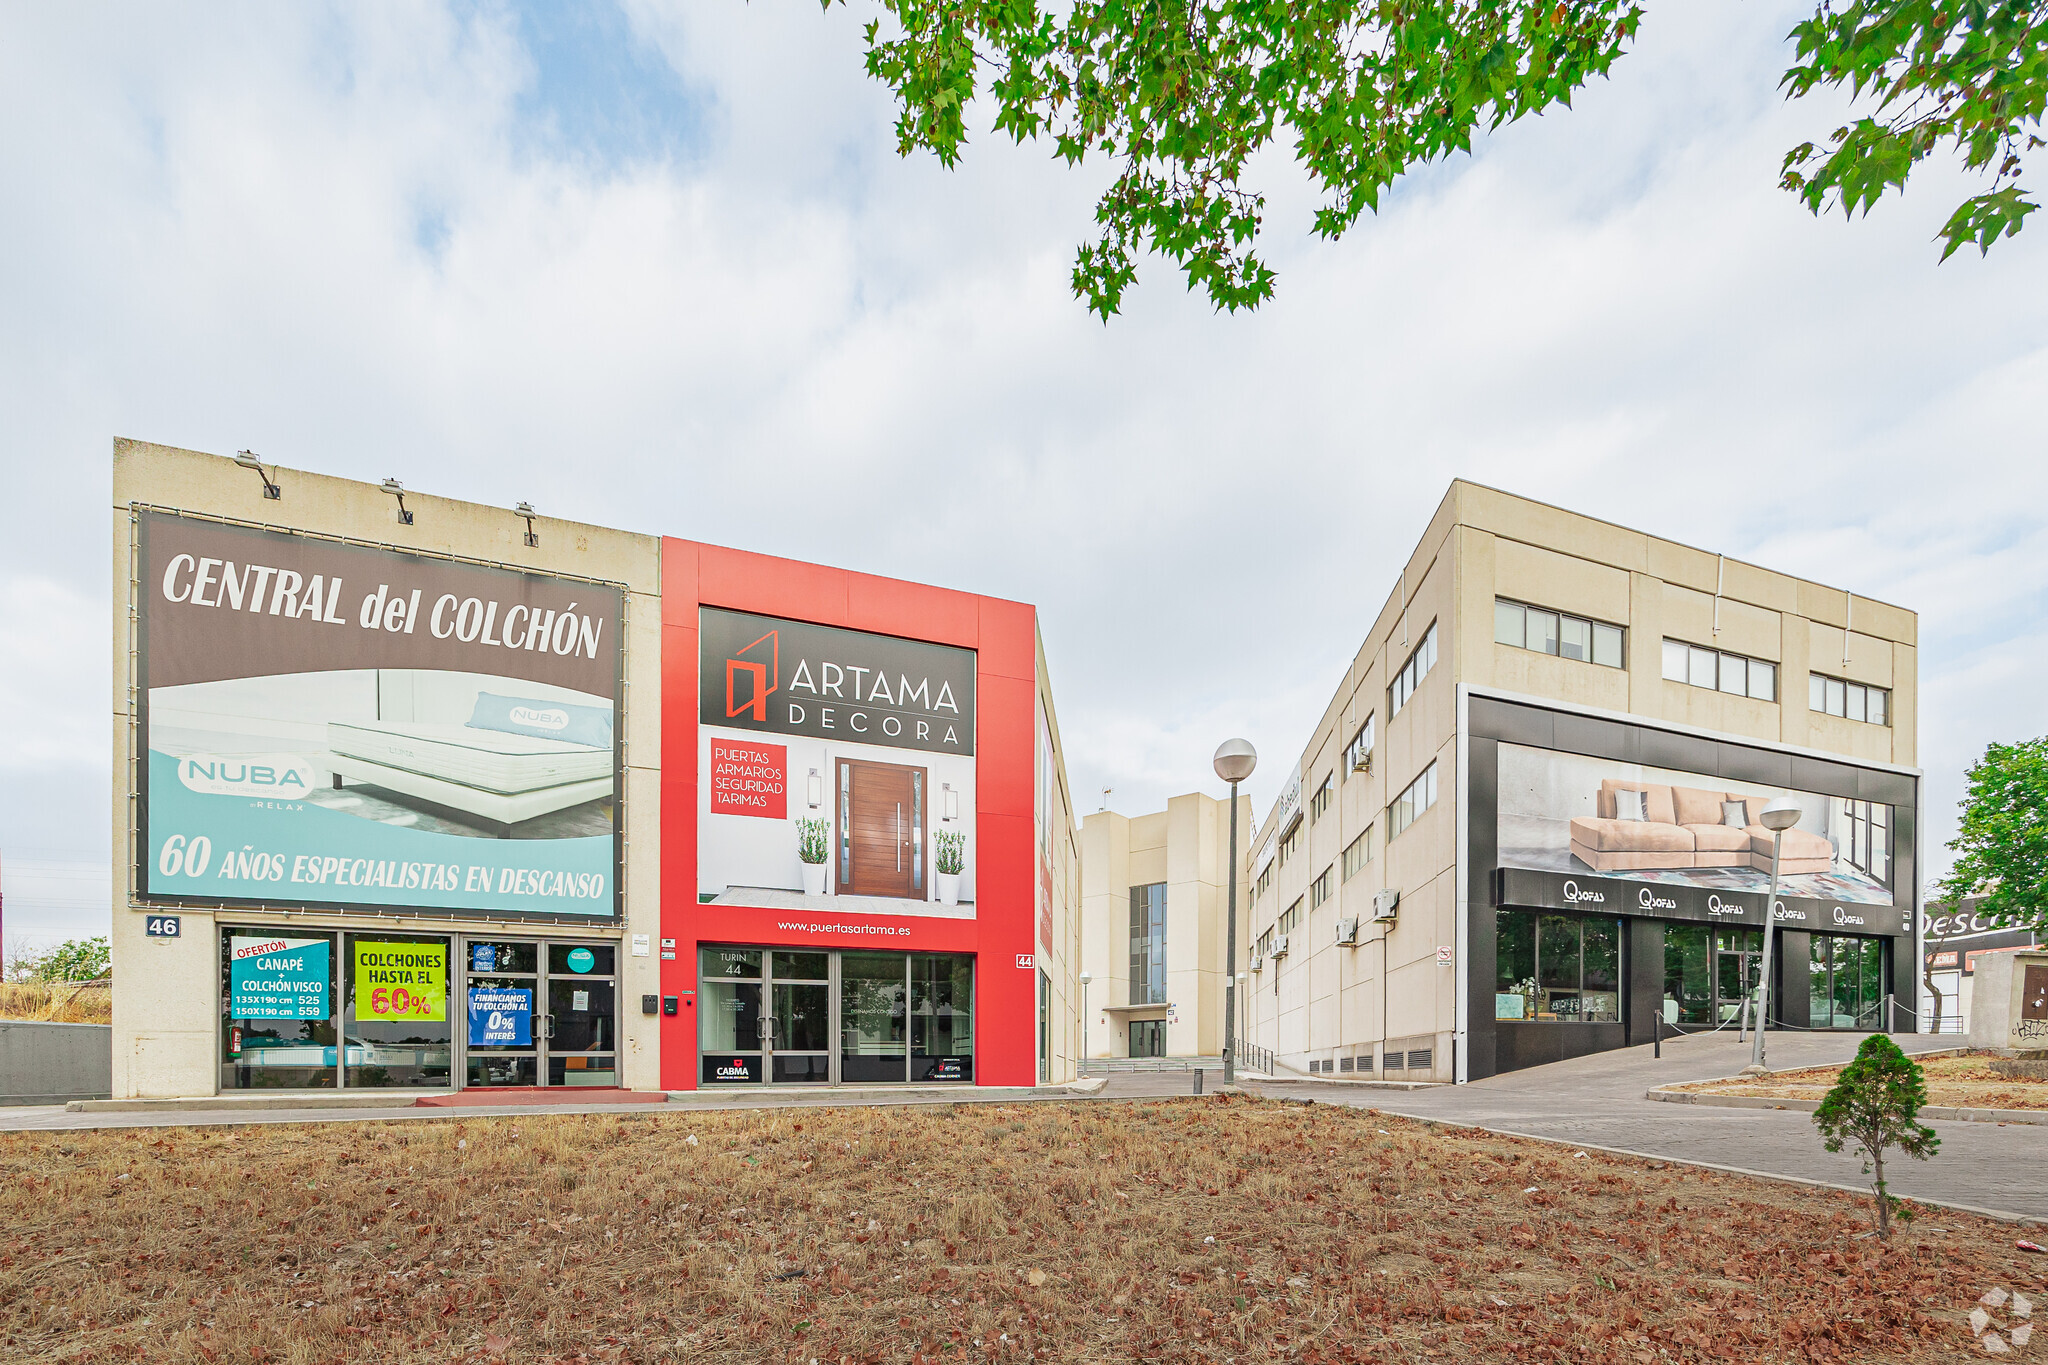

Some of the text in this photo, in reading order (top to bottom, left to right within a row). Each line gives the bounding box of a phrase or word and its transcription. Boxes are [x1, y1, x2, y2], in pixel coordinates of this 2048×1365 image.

[162, 553, 604, 659] CENTRAL del COLCHÓN
[788, 658, 960, 714] ARTAMA
[513, 708, 564, 725] NUBA
[788, 703, 959, 745] DECORA
[715, 747, 770, 764] PUERTAS
[188, 760, 305, 788] NUBA
[715, 763, 782, 780] ARMARIOS
[715, 777, 783, 794] SEGURIDAD
[257, 801, 304, 812] RELAX
[715, 791, 767, 807] TARIMAS
[158, 834, 605, 899] 60 AÑOS ESPECIALISTAS EN DESCANSO
[149, 918, 177, 935] 46
[777, 921, 911, 936] www.puertasartama.es
[236, 940, 287, 959] OFERTÓN
[256, 957, 304, 971] CANAPÉ
[360, 953, 441, 968] COLCHONES
[720, 953, 747, 962] TURIN
[1018, 956, 1033, 967] 44
[368, 969, 433, 984] HASTA EL
[725, 964, 742, 975] 44
[242, 978, 322, 993] COLCHÓN VISCO
[235, 995, 277, 1004] 135X190
[298, 995, 320, 1005] 525
[371, 987, 432, 1015] 60%
[474, 993, 526, 1003] FINANCIAMOS
[235, 1006, 320, 1016] 150X190 cm 559
[473, 1001, 529, 1011] TU COLCHÓN AL
[488, 1011, 514, 1030] 0%
[485, 1031, 516, 1040] INTERÉS
[716, 1067, 749, 1076] CABMA
